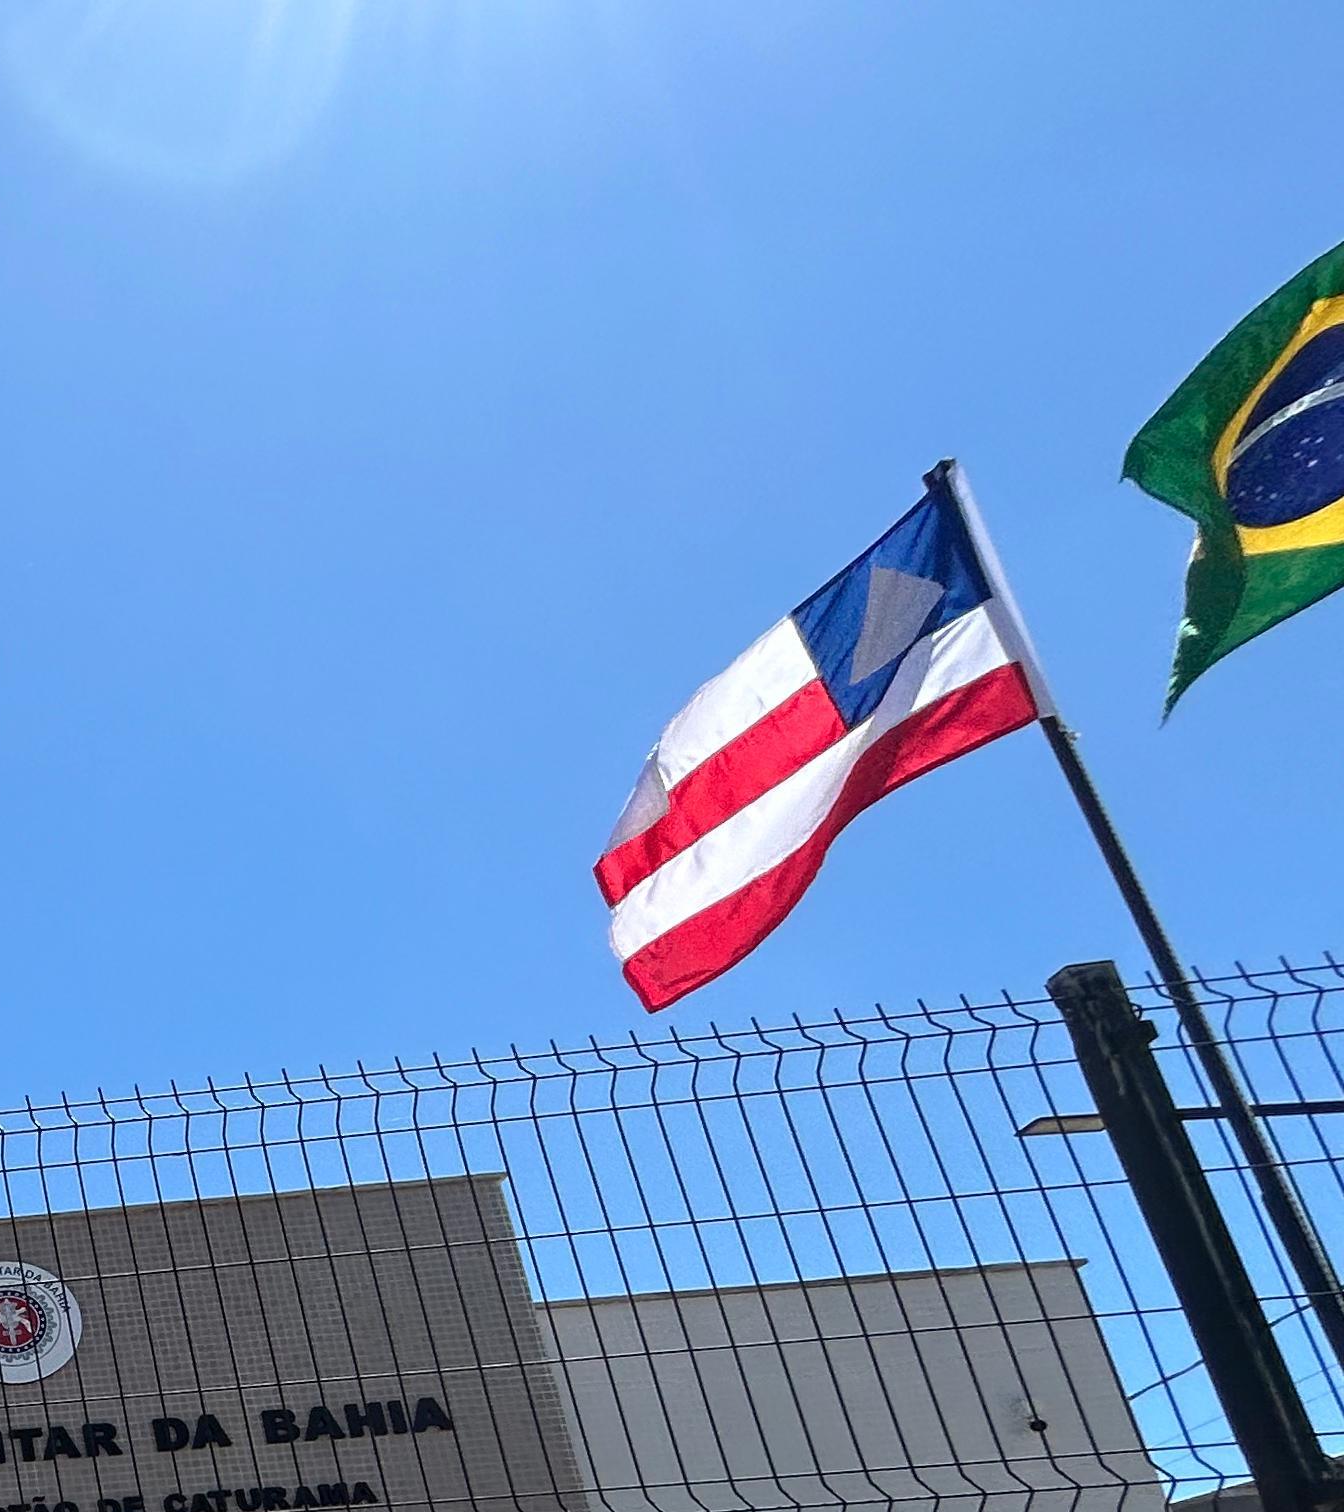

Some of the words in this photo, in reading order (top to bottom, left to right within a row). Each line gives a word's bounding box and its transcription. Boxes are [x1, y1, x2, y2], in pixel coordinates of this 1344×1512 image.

[24, 1270, 42, 1282] DA
[152, 1414, 232, 1452] DA
[260, 1397, 452, 1444] BAHIA
